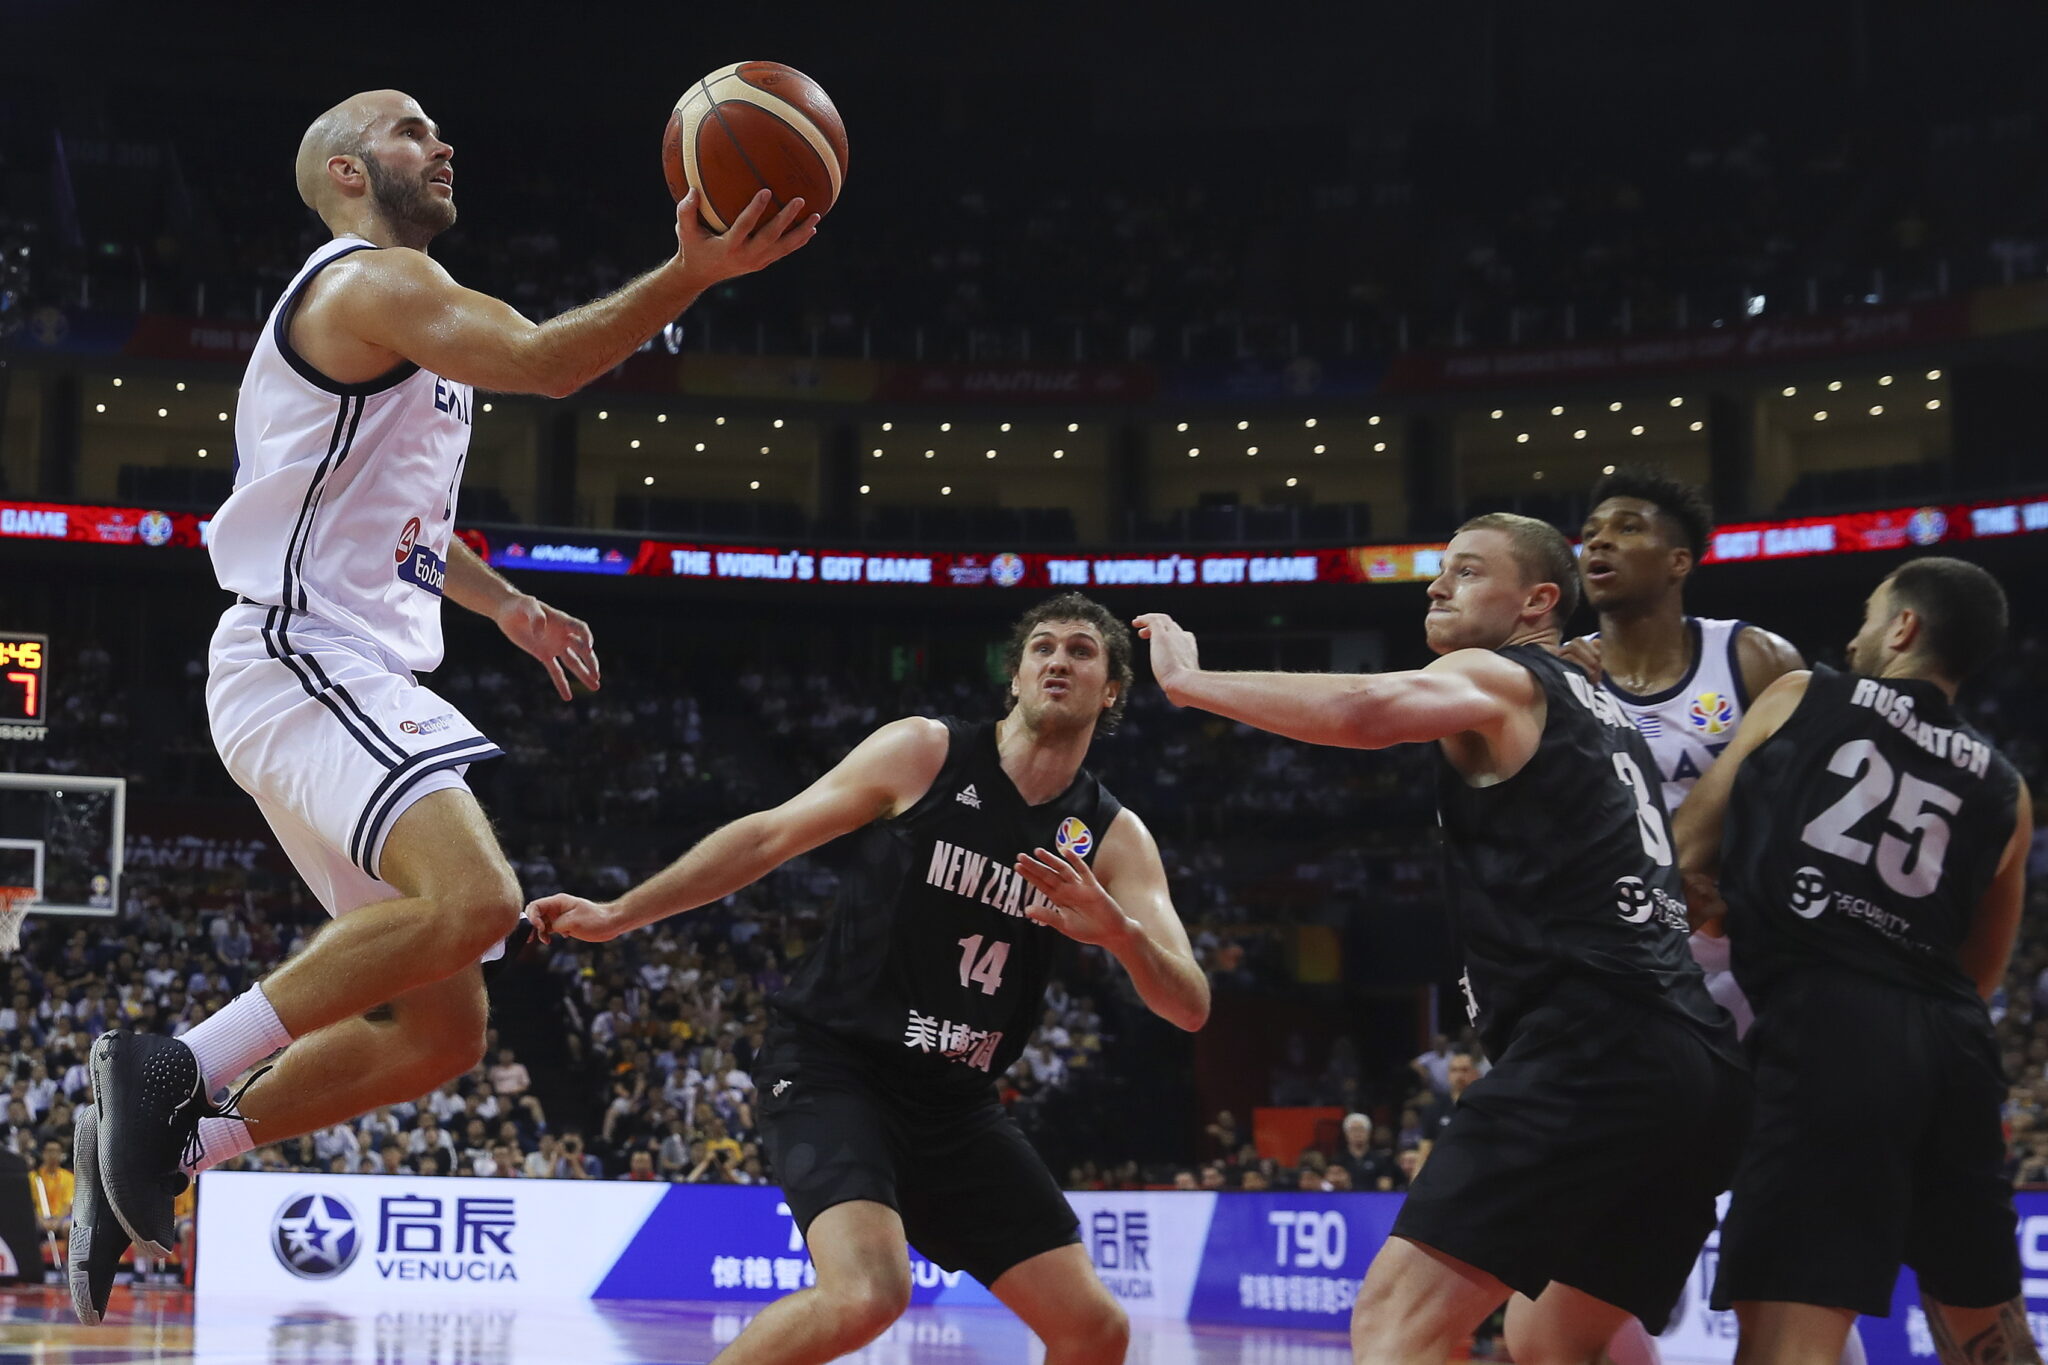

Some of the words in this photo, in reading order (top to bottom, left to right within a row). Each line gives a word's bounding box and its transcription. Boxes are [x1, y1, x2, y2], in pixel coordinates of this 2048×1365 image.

[1, 508, 68, 537] GAME
[1714, 531, 1759, 559] GOT
[1763, 523, 1835, 555] GAME
[671, 550, 711, 575] THE
[716, 550, 814, 580] WORLD'S
[820, 556, 864, 581] GOT
[866, 558, 932, 583] GAME
[1046, 559, 1089, 584] THE
[1094, 554, 1196, 584] WORLD'S
[1202, 557, 1247, 584] GOT
[1249, 556, 1318, 582] GAME
[1801, 739, 1963, 898] 25
[926, 839, 989, 898] NEW
[957, 933, 1011, 996] 14
[377, 1194, 516, 1255] 启辰
[1093, 1210, 1150, 1270] 启辰
[1268, 1211, 1347, 1269] T90
[376, 1260, 518, 1282] VENUCIA
